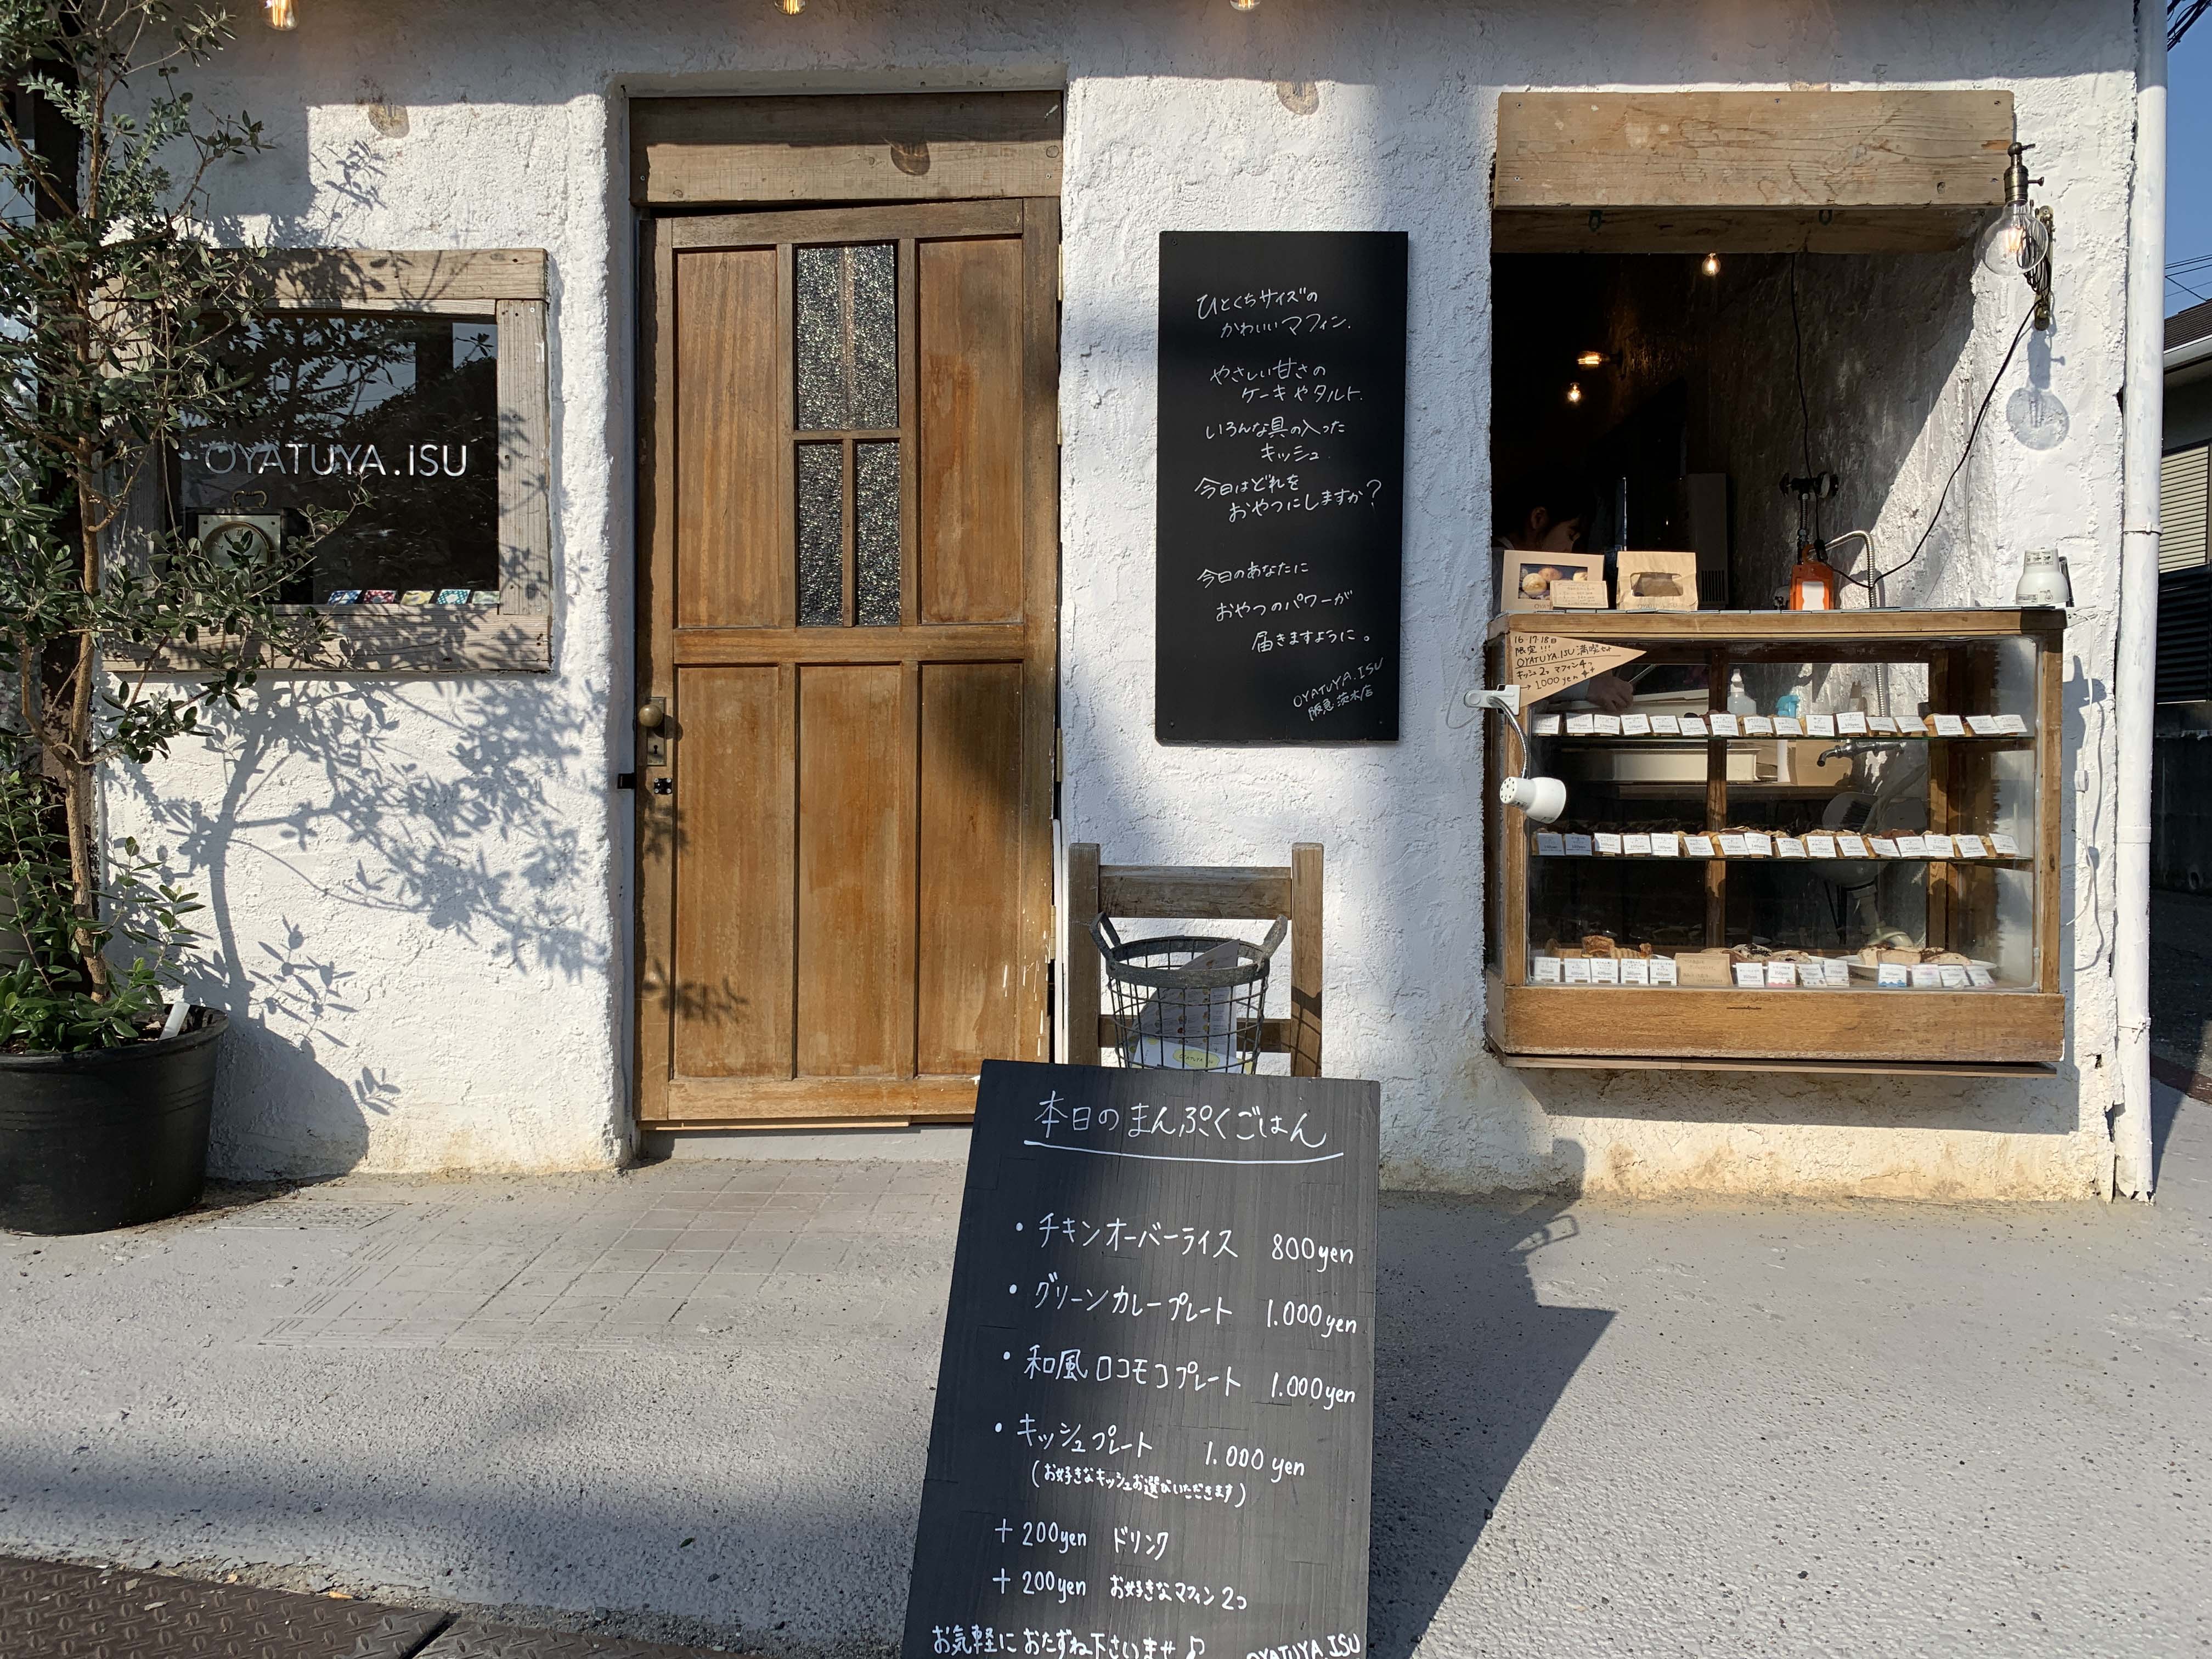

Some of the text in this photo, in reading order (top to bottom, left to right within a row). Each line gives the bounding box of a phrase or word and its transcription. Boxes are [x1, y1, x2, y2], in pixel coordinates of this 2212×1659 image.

[1197, 287, 1318, 319] ひとくちサイズの
[1210, 358, 1325, 385] やさしい甘さの
[1206, 416, 1345, 439] いろんな具の入った
[1194, 474, 1299, 499] 今日はどれを
[1197, 561, 1308, 588] 今日のあなたに
[1216, 590, 1352, 621] おやつのパワーが
[1293, 657, 1384, 707] OYATUYA.ISU
[1034, 1090, 1326, 1148] 本日のまんぷくごはん
[1039, 1212, 1238, 1258] チキンオーバーライス
[1035, 1272, 1232, 1324] グリーンカレープレート
[1024, 1345, 1241, 1397] 和風ロコモコプレート
[1017, 1413, 1153, 1458] キッシュプレート
[1114, 1526, 1169, 1560] ドリンク
